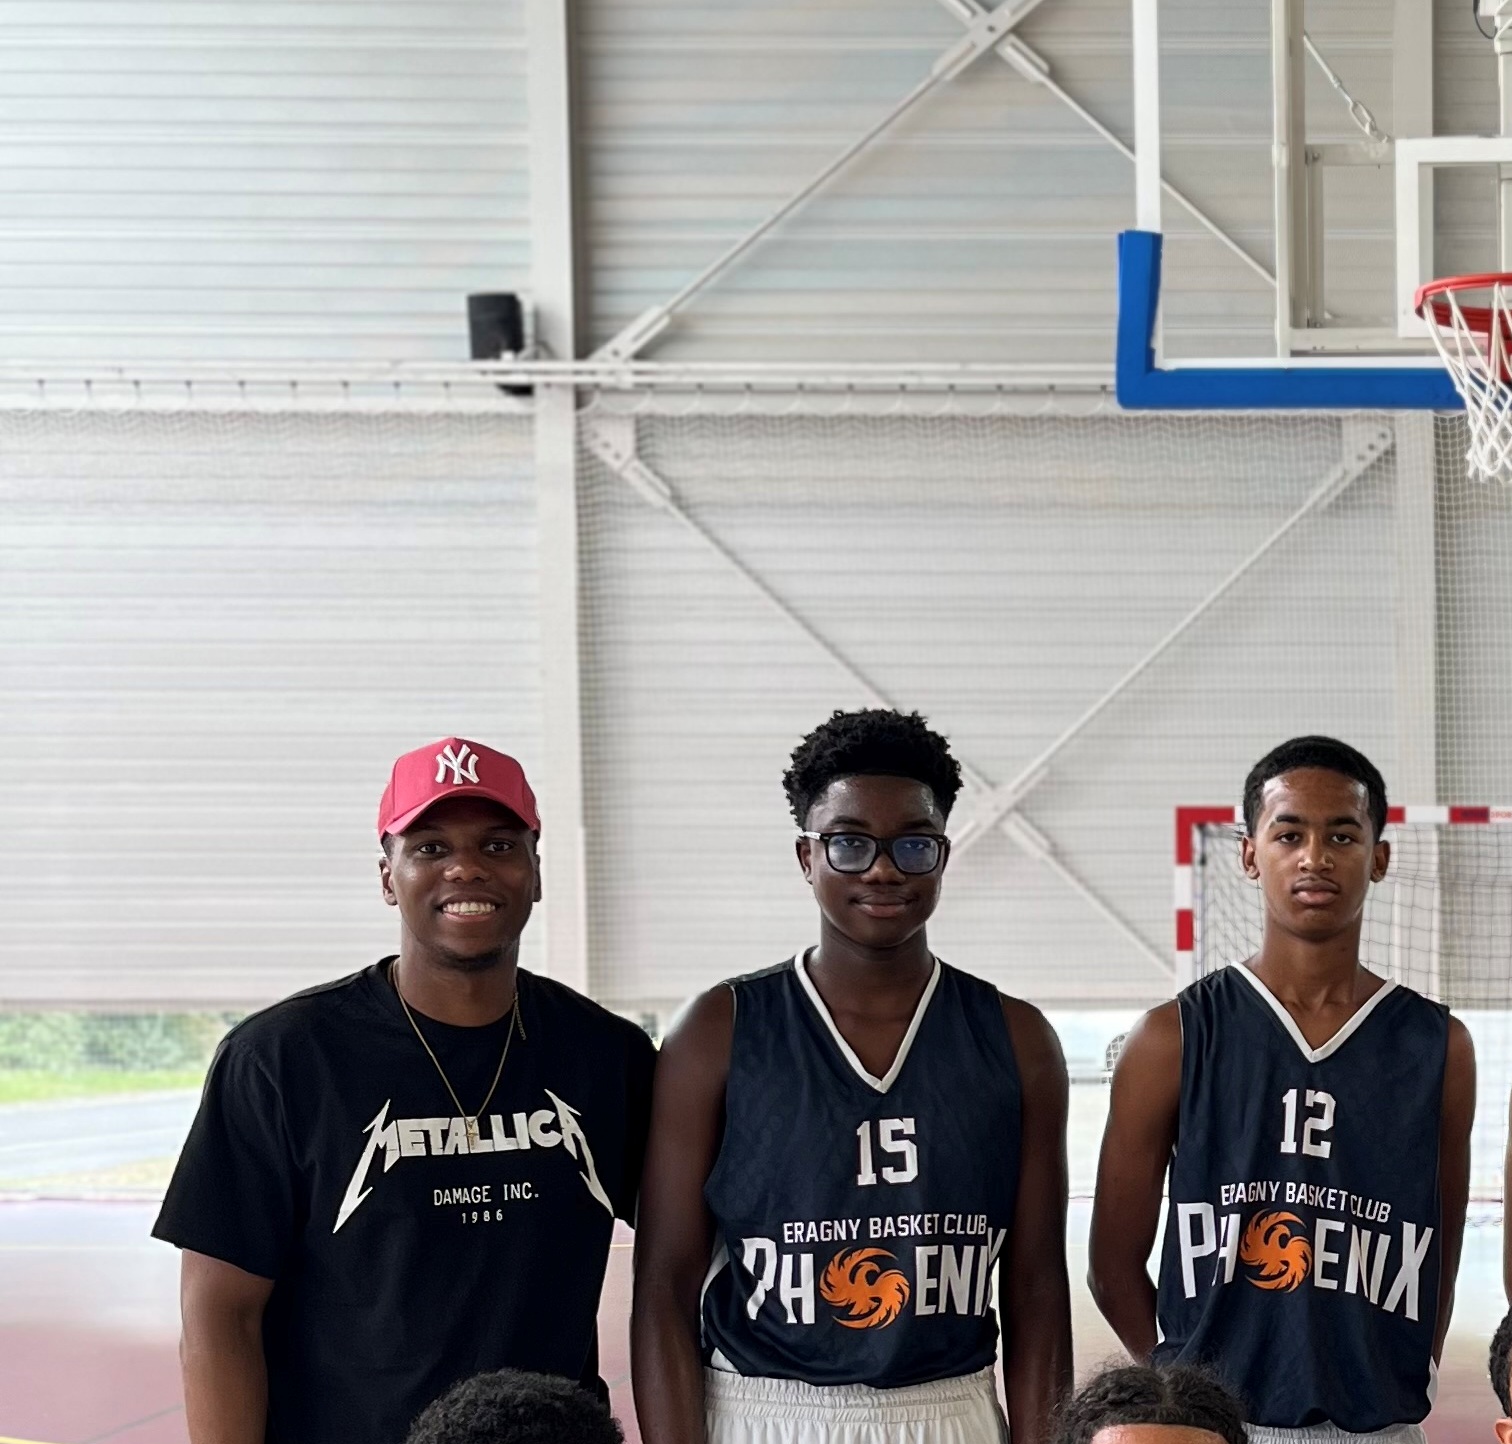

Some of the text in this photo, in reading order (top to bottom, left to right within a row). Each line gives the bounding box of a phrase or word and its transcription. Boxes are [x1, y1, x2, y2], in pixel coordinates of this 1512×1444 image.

[435, 744, 479, 784] NY
[1280, 1089, 1336, 1158] 12
[333, 1089, 614, 1233] METALLICA
[857, 1118, 918, 1186] 15
[433, 1181, 539, 1206] DAMAGE INC.
[1221, 1181, 1391, 1223] ERAGNY BASKET CLUB
[461, 1208, 503, 1224] 1986
[783, 1214, 987, 1243] ERAGNY BASKET CLUB
